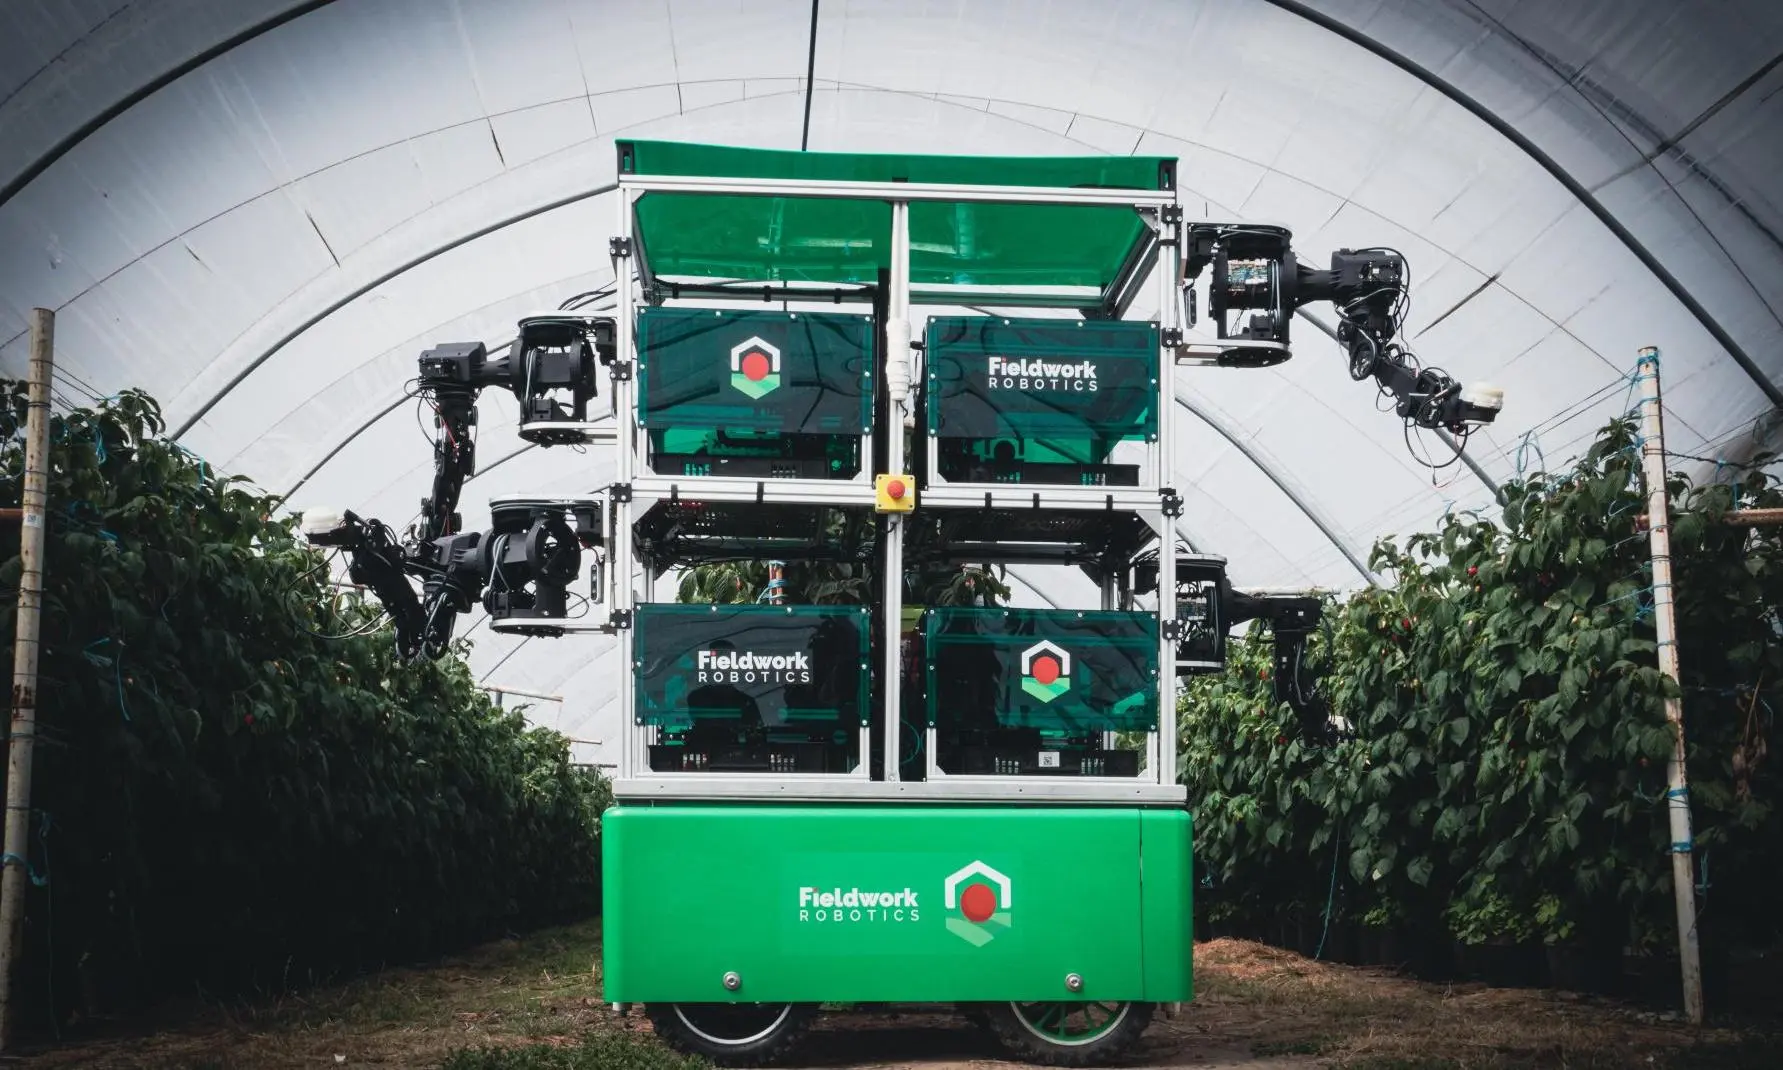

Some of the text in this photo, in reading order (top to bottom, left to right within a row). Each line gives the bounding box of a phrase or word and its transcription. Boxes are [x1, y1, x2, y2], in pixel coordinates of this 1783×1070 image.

[989, 357, 1096, 378] Fieldwork
[989, 377, 1098, 391] ROBOTICS
[698, 650, 808, 669] Fieldwork
[698, 671, 809, 682] ROBOTICS
[800, 887, 918, 907] Fieldwork
[800, 909, 919, 921] ROBOTICS
